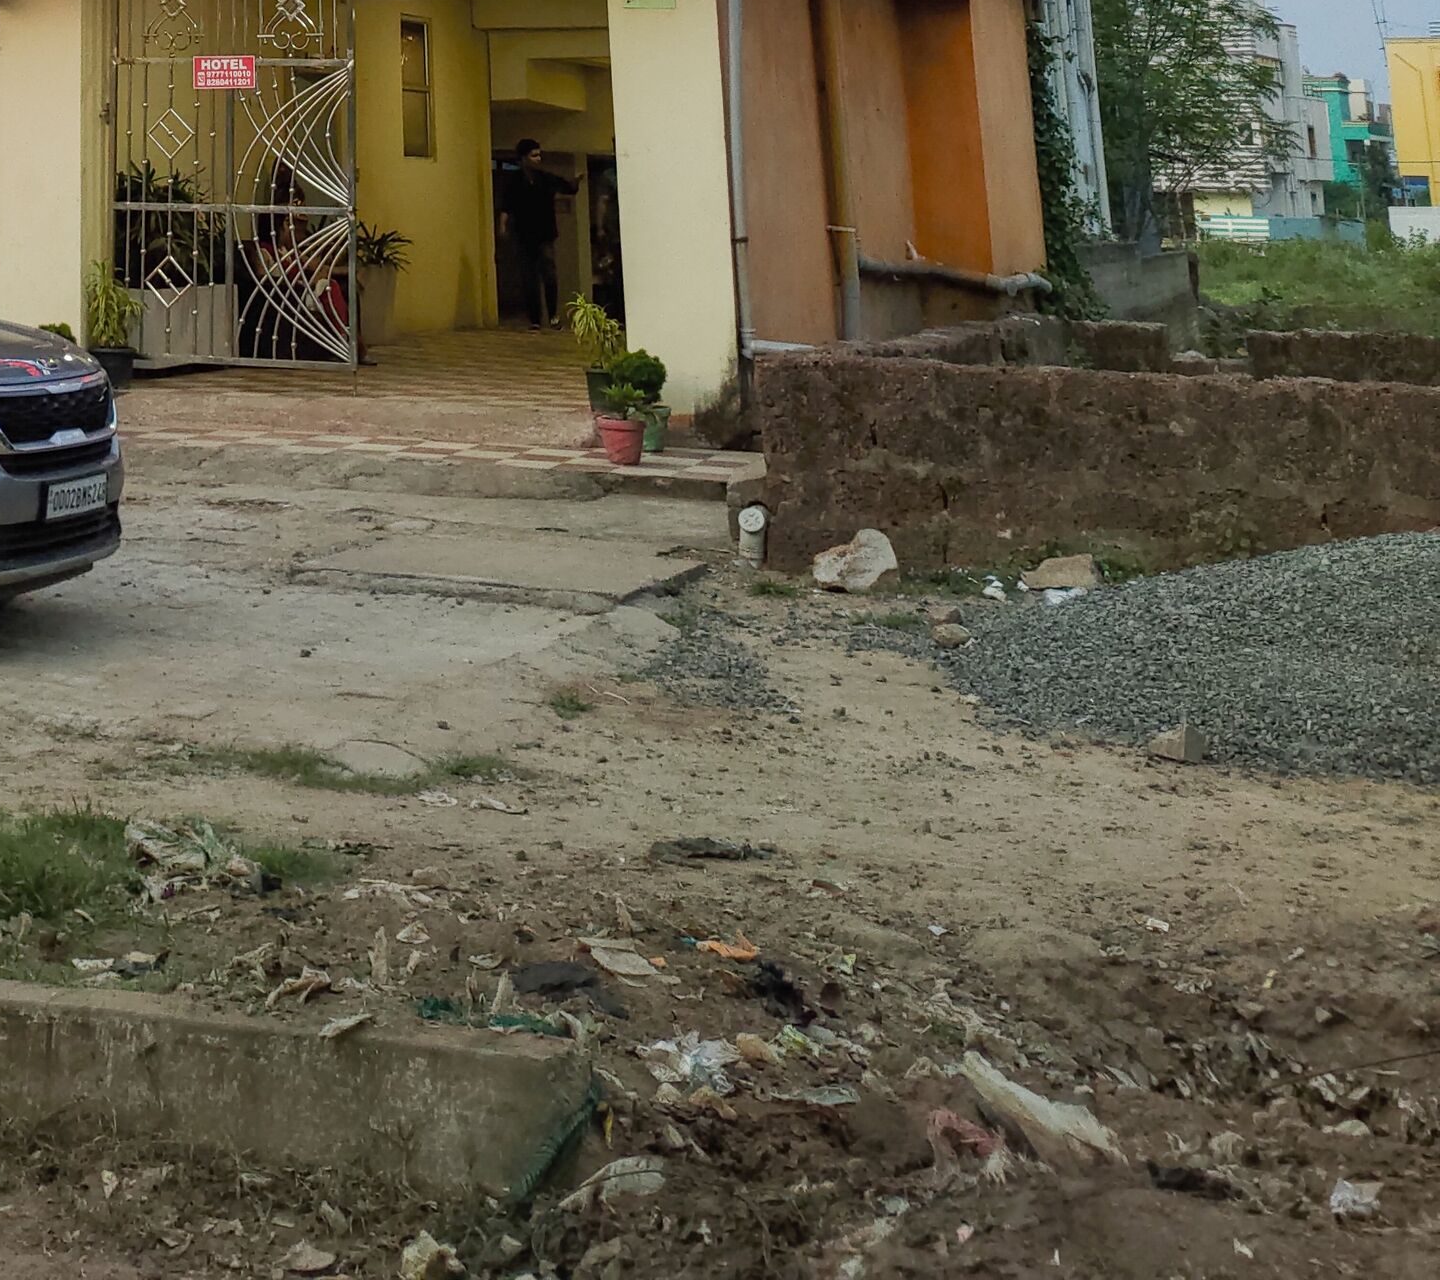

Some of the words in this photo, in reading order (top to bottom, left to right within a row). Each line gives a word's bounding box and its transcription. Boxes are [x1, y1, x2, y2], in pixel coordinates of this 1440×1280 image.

[201, 58, 247, 71] HOTEL
[206, 70, 251, 78] 9777110010
[206, 78, 251, 86] 8260411201
